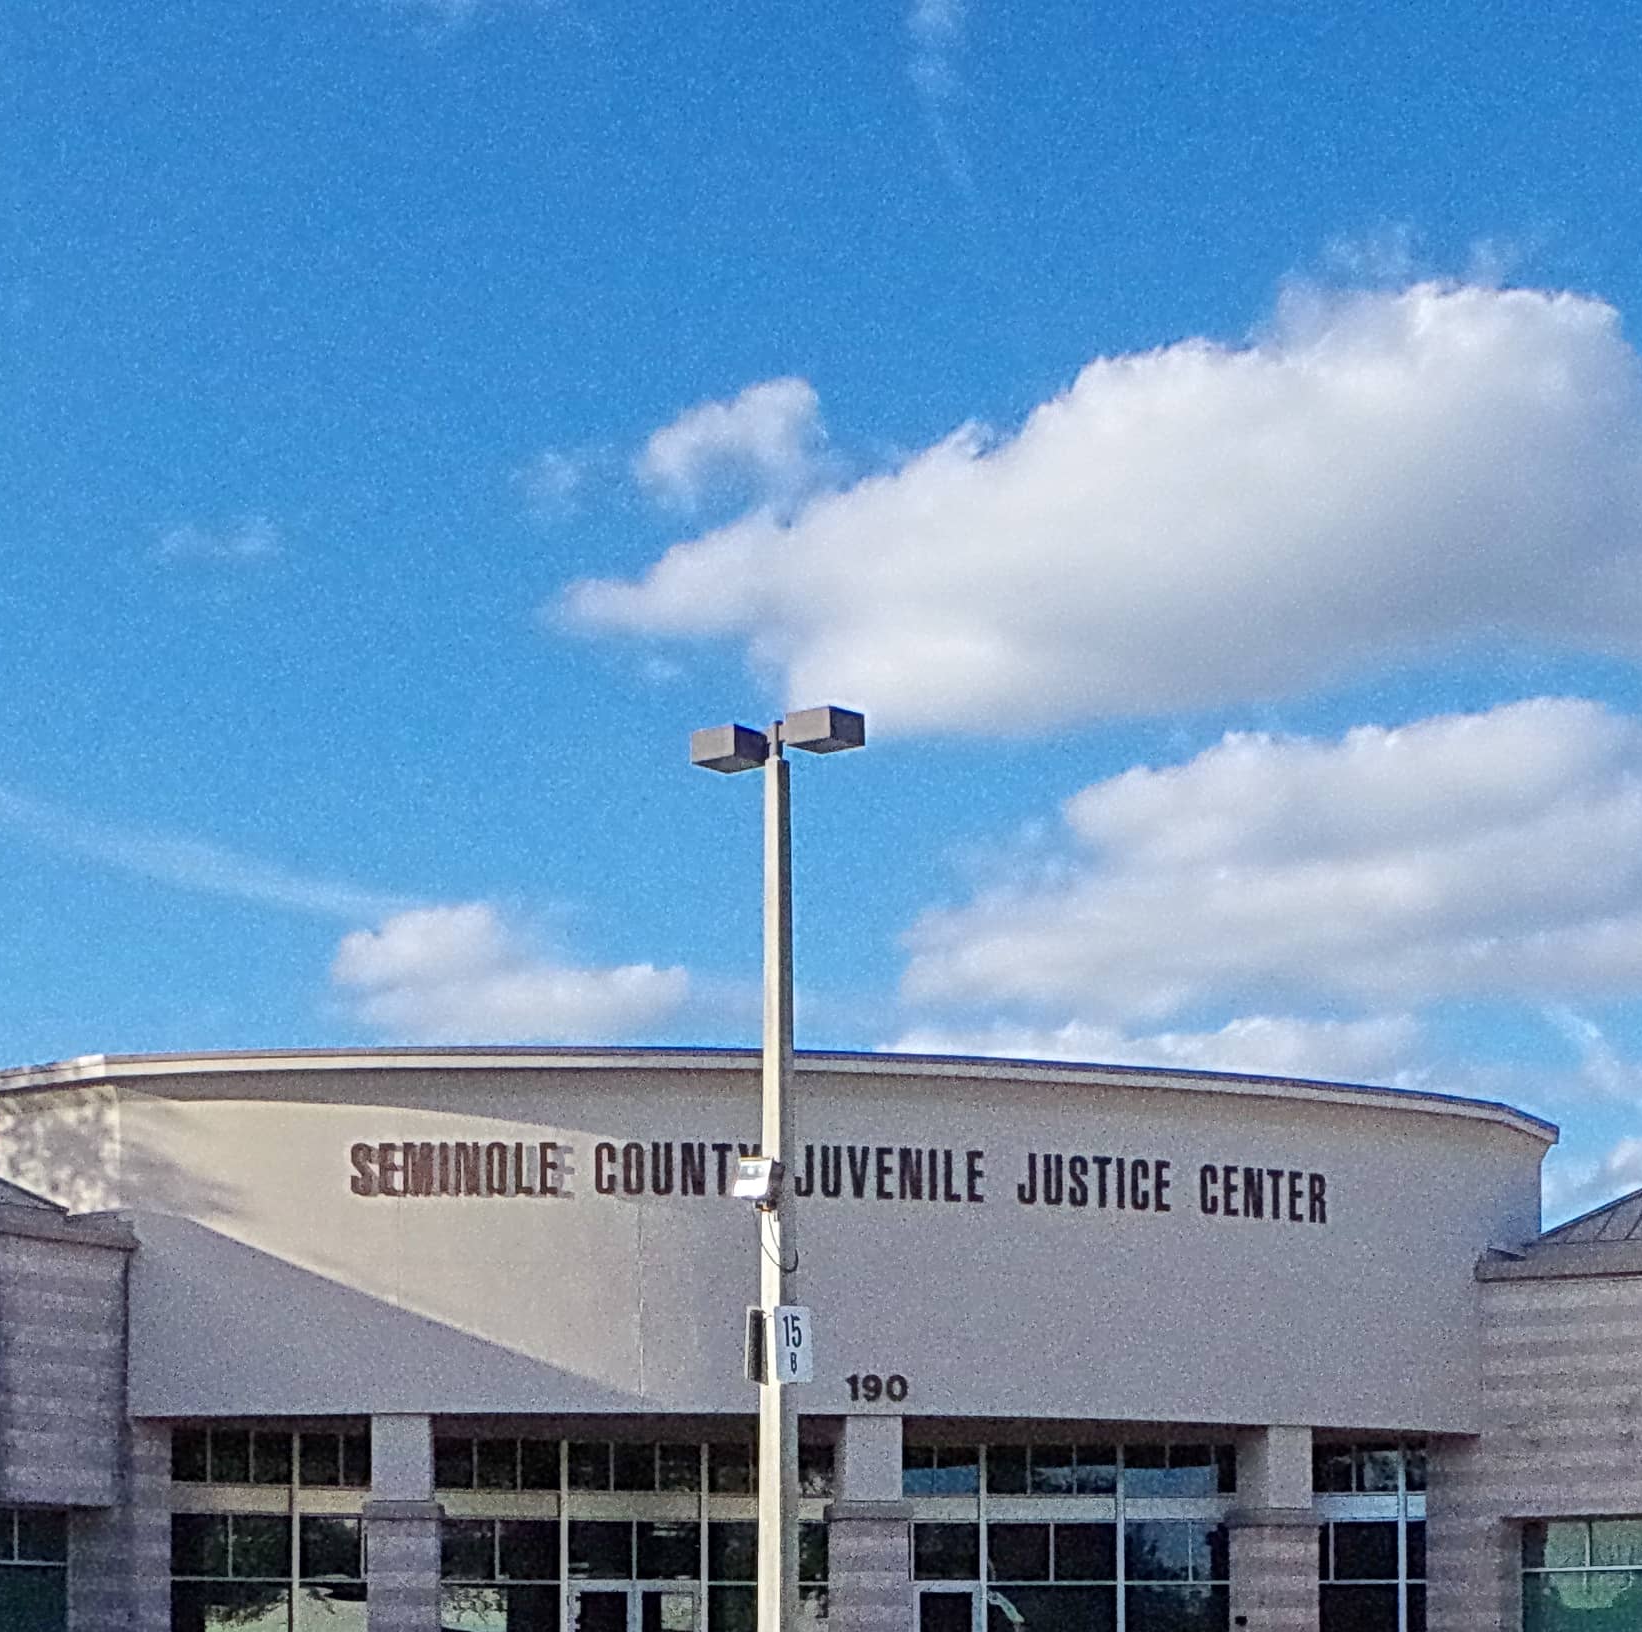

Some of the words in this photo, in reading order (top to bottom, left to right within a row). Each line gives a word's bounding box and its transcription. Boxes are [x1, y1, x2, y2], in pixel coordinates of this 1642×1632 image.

[351, 1141, 559, 1197] SEMINOLE
[794, 1144, 984, 1202] JUVENILE
[1017, 1153, 1172, 1213] JUSTICE
[1200, 1163, 1327, 1224] CENTER
[783, 1313, 803, 1348] 15
[845, 1373, 909, 1402] 190
